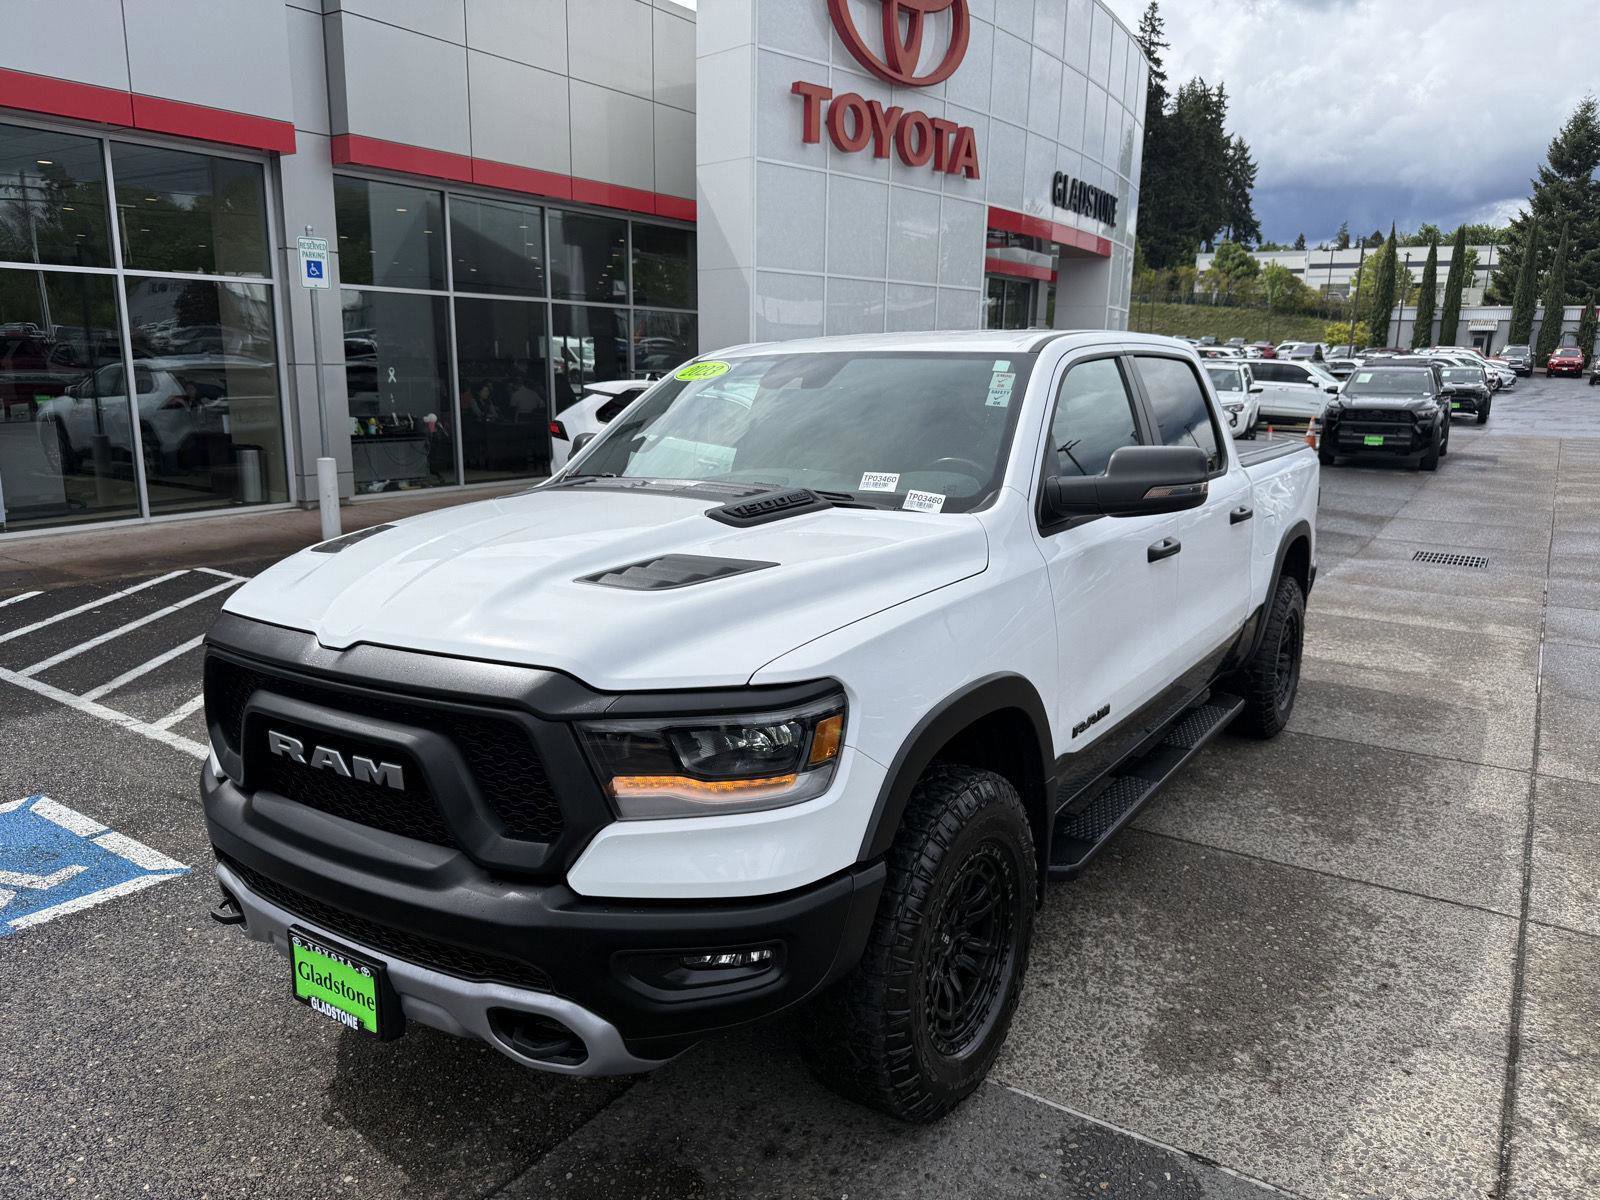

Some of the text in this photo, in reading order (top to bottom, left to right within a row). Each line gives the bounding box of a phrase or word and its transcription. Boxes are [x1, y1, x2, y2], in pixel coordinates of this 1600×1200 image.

[792, 81, 980, 180] TOYOTA
[1052, 170, 1118, 228] GLADSTONE
[299, 241, 326, 251] RESERVED
[301, 250, 326, 259] PARKING
[863, 474, 898, 484] TP03460
[907, 492, 943, 505] TP03460
[1071, 702, 1111, 739] RAM
[268, 730, 405, 792] RAM
[307, 942, 354, 968] TOYOTA
[297, 960, 376, 1012] Gladstone
[310, 996, 359, 1031] GLADSTONE
